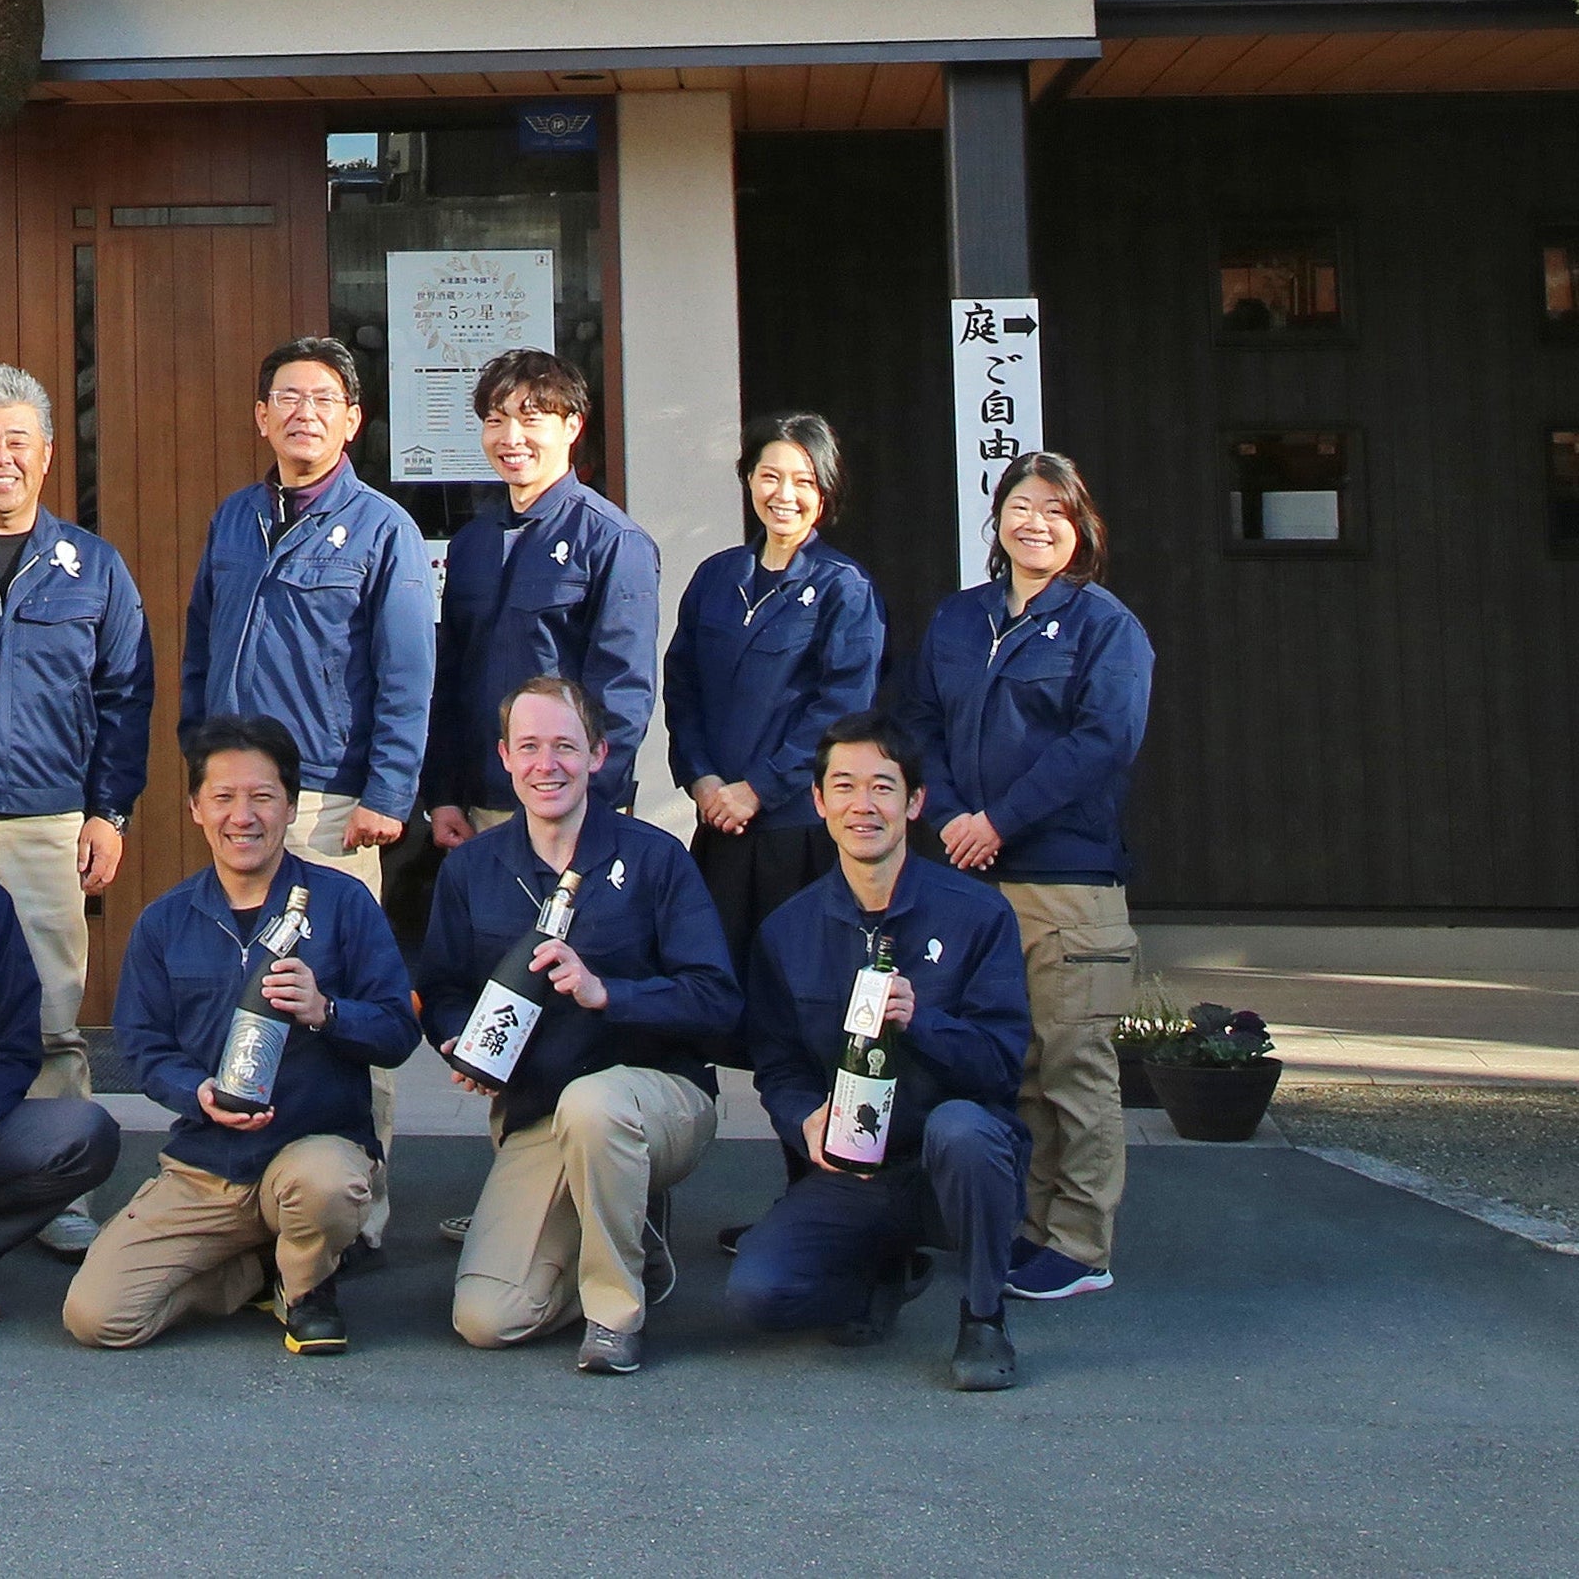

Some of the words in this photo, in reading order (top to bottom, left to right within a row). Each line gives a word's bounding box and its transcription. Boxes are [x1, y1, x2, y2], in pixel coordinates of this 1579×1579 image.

[449, 304, 495, 320] 5つ星
[959, 302, 999, 346] 庭
[479, 1004, 519, 1058] 今錦
